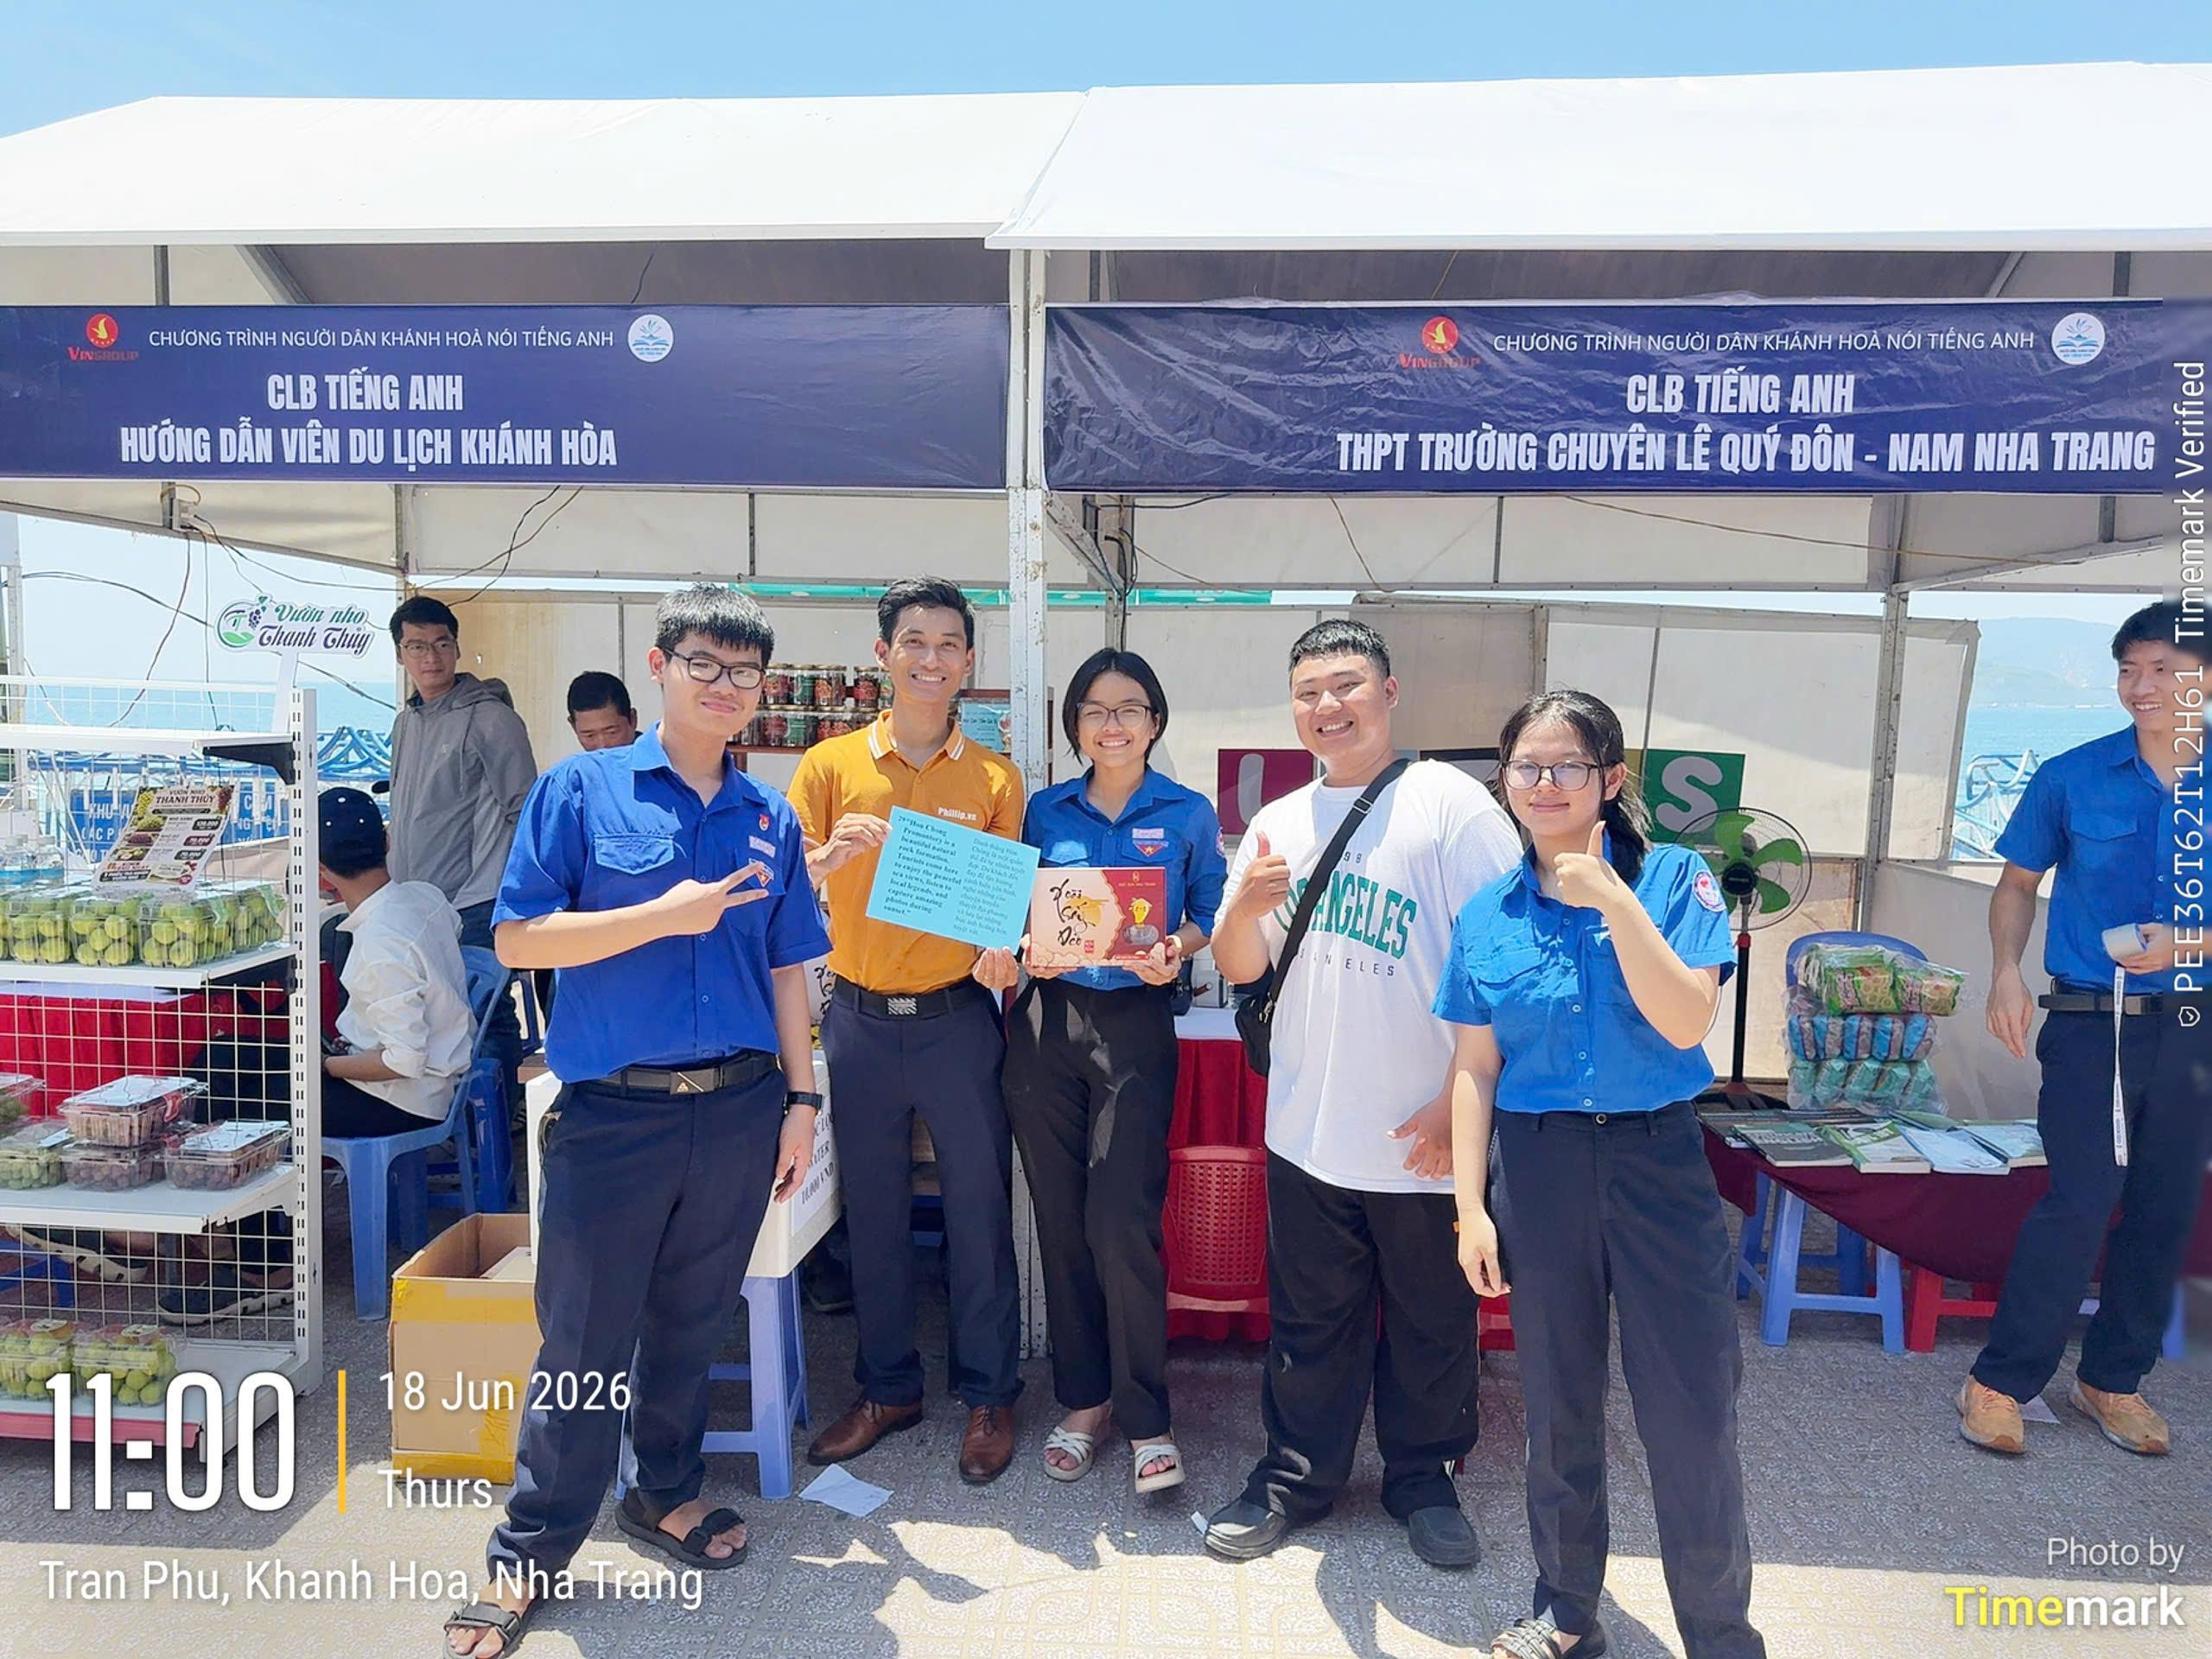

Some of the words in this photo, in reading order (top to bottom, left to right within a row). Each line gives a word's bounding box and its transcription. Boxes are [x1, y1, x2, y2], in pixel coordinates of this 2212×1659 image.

[68, 346, 139, 361] VINGROUP
[149, 330, 221, 346] CHƯƠNG
[226, 327, 276, 346] TRÌNH
[282, 327, 335, 346] NGƯỜI
[341, 327, 377, 346] DÂN
[381, 327, 441, 346] KHÁNH
[445, 327, 483, 346] HOÀ
[487, 328, 517, 346] NÓI
[522, 326, 571, 347] TIẾNG
[575, 331, 613, 346] ANH
[1494, 334, 1577, 352] CHƯƠNG
[1585, 332, 1641, 352] TRÌNH
[1649, 331, 1707, 352] NGƯỜI
[1717, 331, 1758, 351] DÂN
[1764, 331, 1832, 351] KHÁNH
[1839, 329, 1880, 350] HOÀ
[1887, 329, 1922, 350] NÓI
[1930, 327, 1985, 349] TIẾNG
[1991, 332, 2034, 349] ANH
[267, 374, 316, 410] CLB
[325, 366, 400, 410] TIẾNG
[409, 374, 464, 410] ANH
[1627, 374, 1684, 413] CLB
[1694, 365, 1780, 413] TIẾNG
[1789, 374, 1854, 413] ANH
[121, 418, 211, 464] HƯỚNG
[219, 416, 272, 464] DẪN
[281, 419, 340, 464] VIÊN
[349, 429, 385, 464] DU
[394, 429, 452, 472] LỊCH
[461, 420, 552, 465] KHÁNH
[562, 420, 617, 466] HÒA
[1337, 433, 1410, 471] THPT
[1418, 423, 1537, 471] TRƯỜNG
[1548, 423, 1665, 471] CHUYÊN
[1676, 423, 1713, 471] LÊ
[1720, 423, 1782, 474] QUÝ
[1790, 423, 1854, 472] ĐÔN
[1888, 433, 1964, 472] NAM
[1974, 433, 2039, 471] NHA
[2051, 431, 2156, 471] TRANG
[275, 603, 325, 623] Vườn
[329, 607, 365, 624] nho
[259, 625, 317, 648] Thanh
[323, 626, 372, 655] Thủy
[1655, 756, 1723, 834] S
